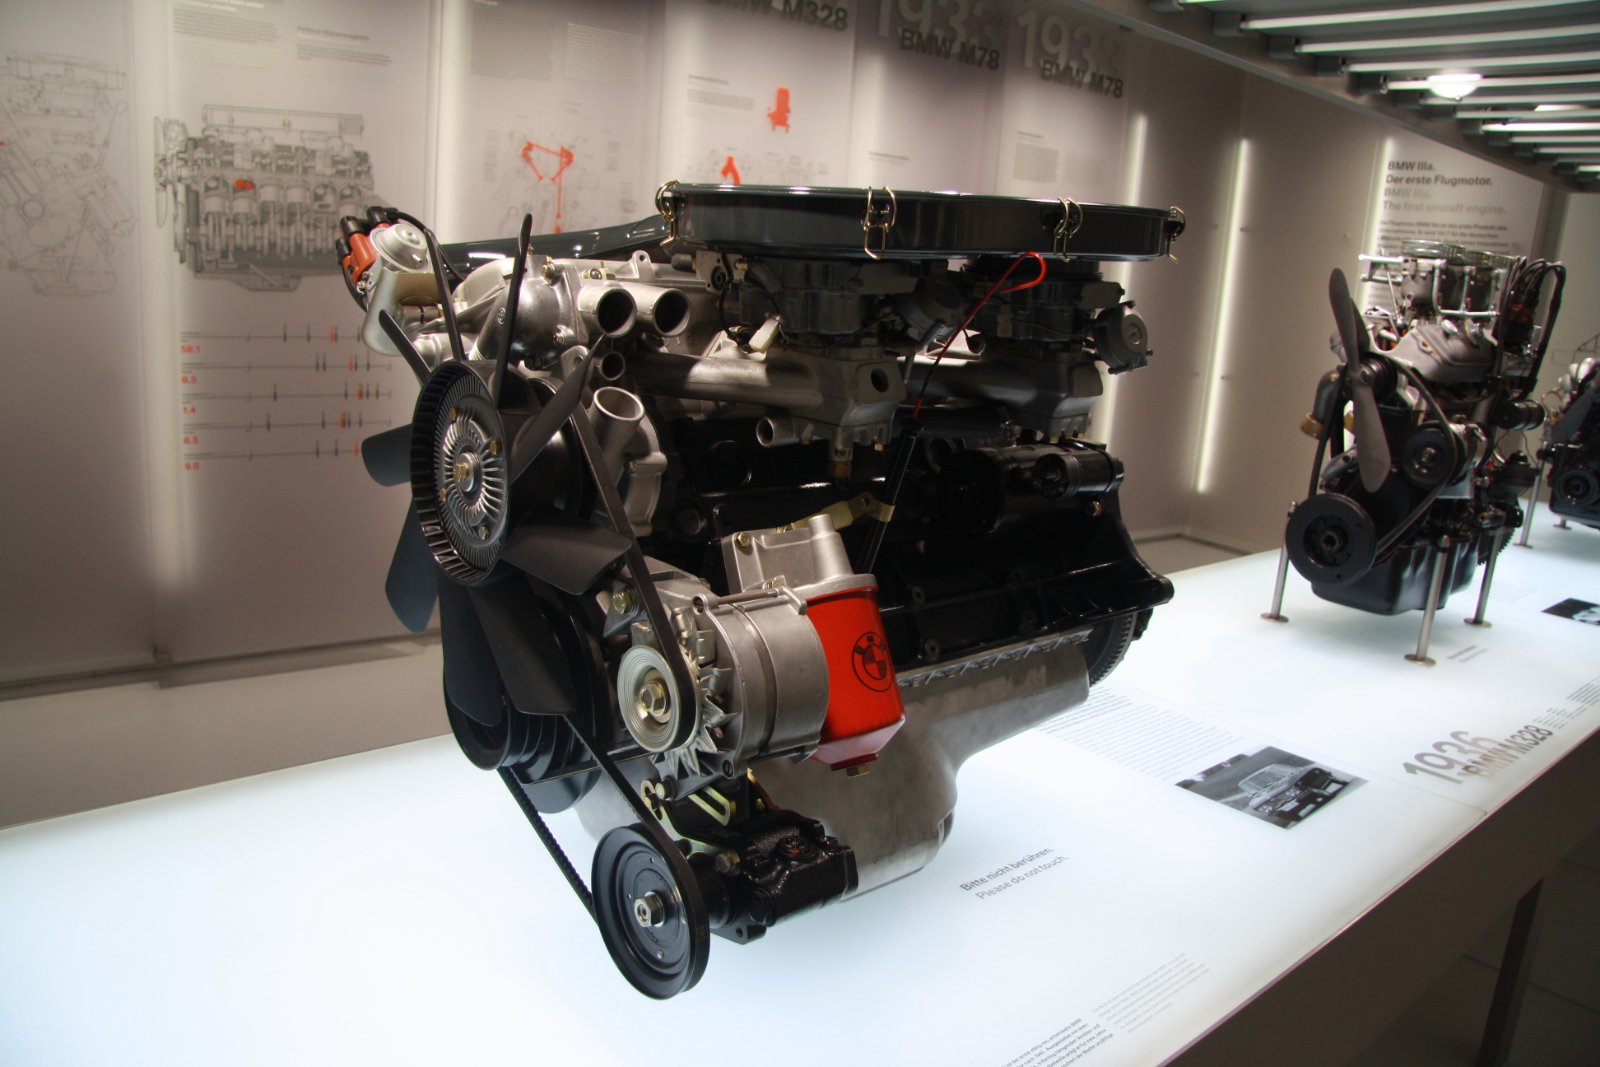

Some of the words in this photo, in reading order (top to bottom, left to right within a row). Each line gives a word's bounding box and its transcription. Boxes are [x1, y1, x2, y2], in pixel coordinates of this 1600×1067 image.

[782, 0, 849, 32] M328
[899, 27, 955, 60] BMW
[957, 40, 1001, 71] M78
[1039, 59, 1087, 88] BMW
[1088, 74, 1125, 99] M78
[1386, 174, 1405, 185] Der
[1405, 176, 1432, 186] erste
[1433, 174, 1493, 188] Flugmotor.
[1388, 160, 1416, 171] BMW
[1497, 724, 1553, 755] M328
[1402, 730, 1506, 785] 1936
[959, 877, 989, 891] Bitte
[986, 865, 1012, 880] nicht
[975, 881, 1012, 899] Please
[1010, 875, 1025, 884] do
[1024, 865, 1042, 878] not
